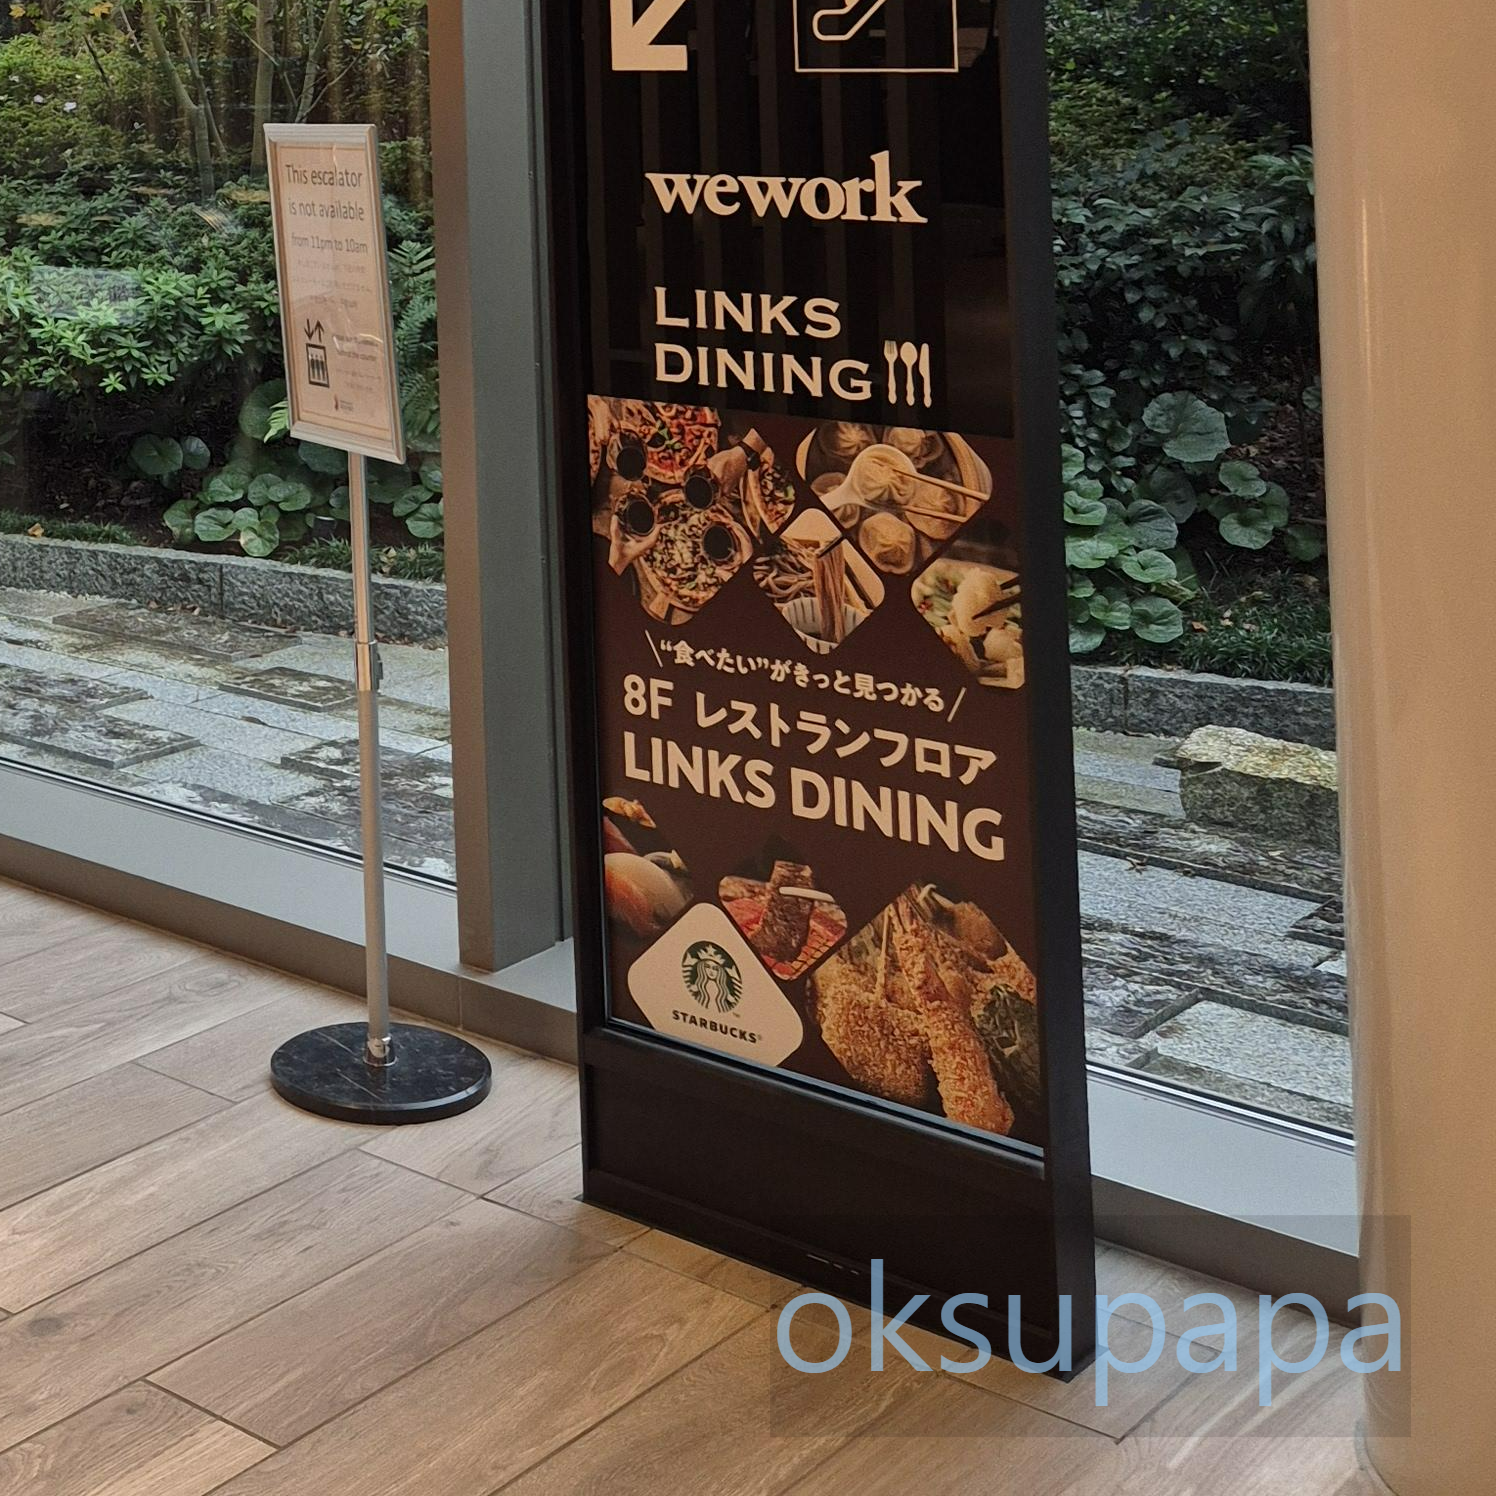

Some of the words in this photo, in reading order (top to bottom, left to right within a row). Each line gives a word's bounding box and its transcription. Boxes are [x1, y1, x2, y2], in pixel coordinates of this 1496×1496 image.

[285, 164, 308, 185] This
[311, 165, 363, 188] escalator
[644, 150, 929, 224] wework
[288, 198, 297, 216] is
[299, 201, 317, 217] not
[319, 200, 365, 221] available
[291, 232, 309, 247] from
[311, 235, 333, 251] 11pm
[334, 237, 343, 251] to
[345, 239, 368, 254] 10am
[654, 286, 842, 340] LINKS
[654, 342, 873, 401] DINING
[623, 673, 675, 720] 8F
[695, 691, 997, 786] レストランフロア
[623, 731, 776, 809] LINKS
[790, 766, 1005, 861] DINING
[672, 1009, 758, 1044] STARBUCKS
